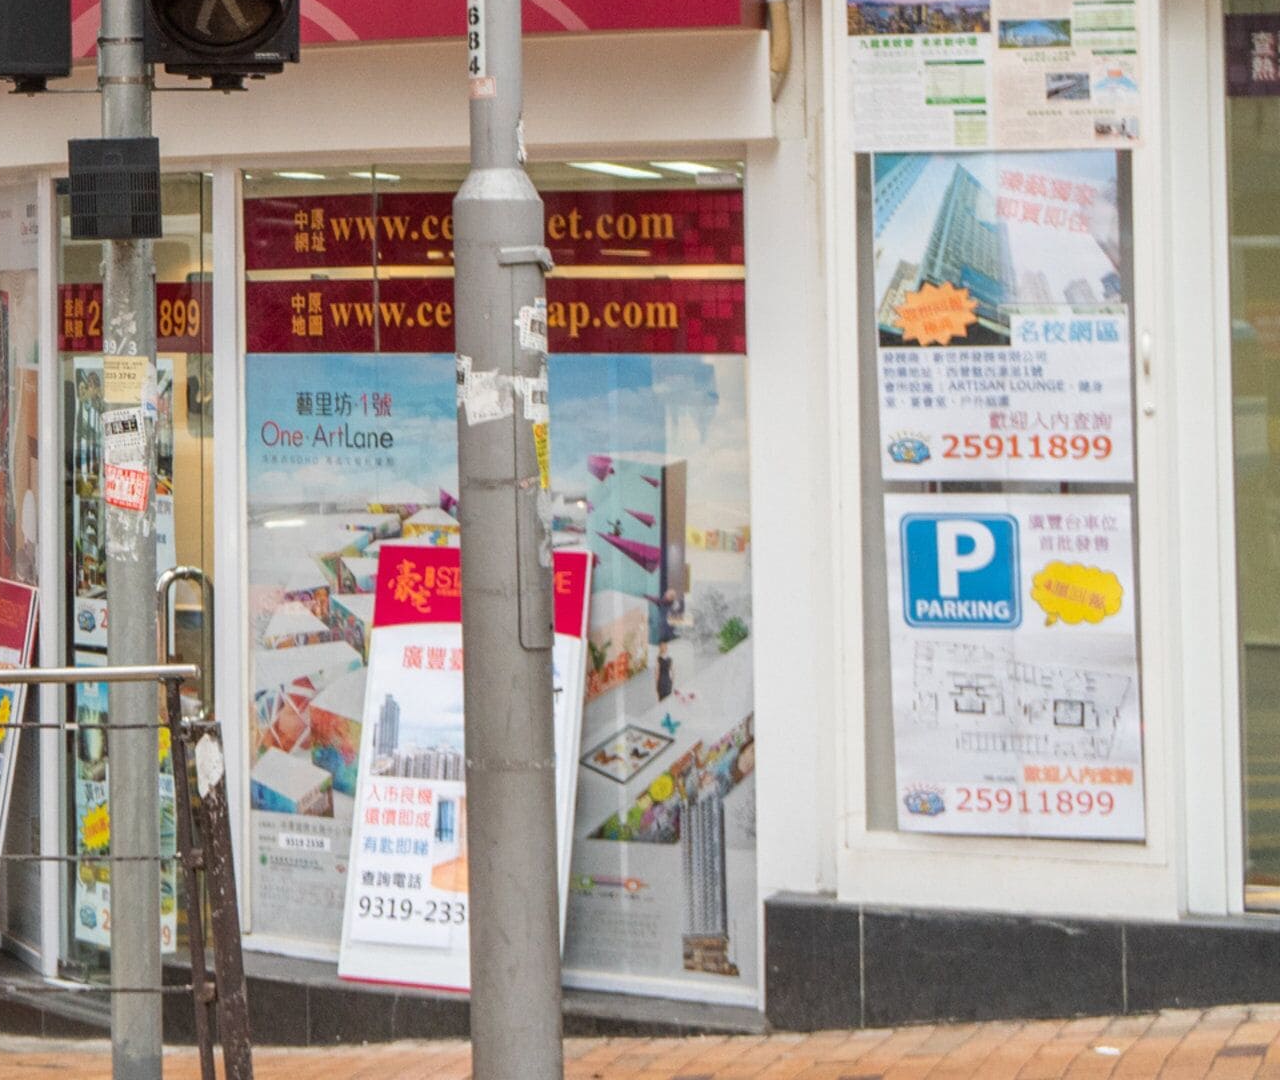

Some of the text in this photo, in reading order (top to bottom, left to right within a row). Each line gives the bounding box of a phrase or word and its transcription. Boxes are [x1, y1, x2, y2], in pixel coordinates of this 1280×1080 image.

[941, 434, 1113, 460] 25911899
[936, 520, 996, 598] P
[915, 598, 1010, 620] PARKING
[955, 787, 1115, 816] 25911899
